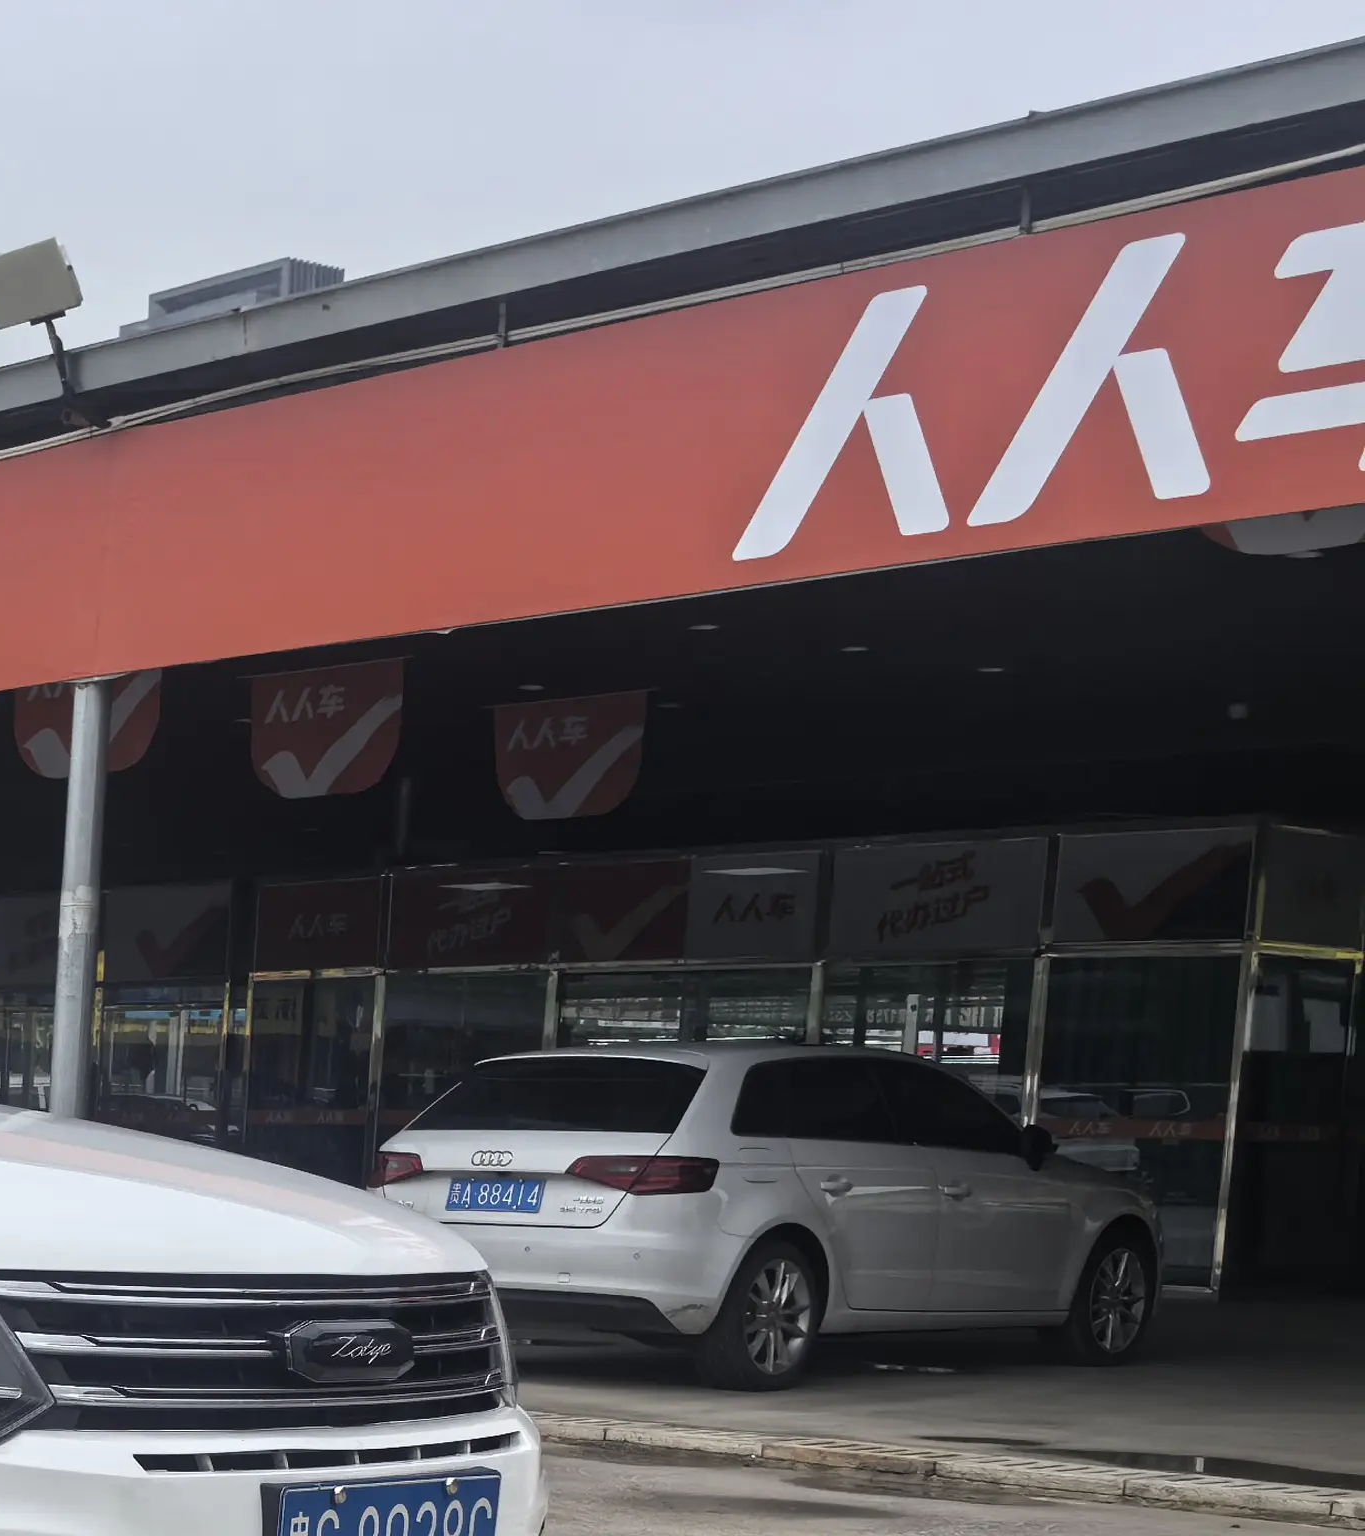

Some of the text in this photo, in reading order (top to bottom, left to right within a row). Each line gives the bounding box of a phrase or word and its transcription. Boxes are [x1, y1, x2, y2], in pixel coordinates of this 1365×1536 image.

[265, 684, 346, 724] 人人车
[506, 716, 588, 752] 人人车
[331, 1336, 392, 1364] Zotye
